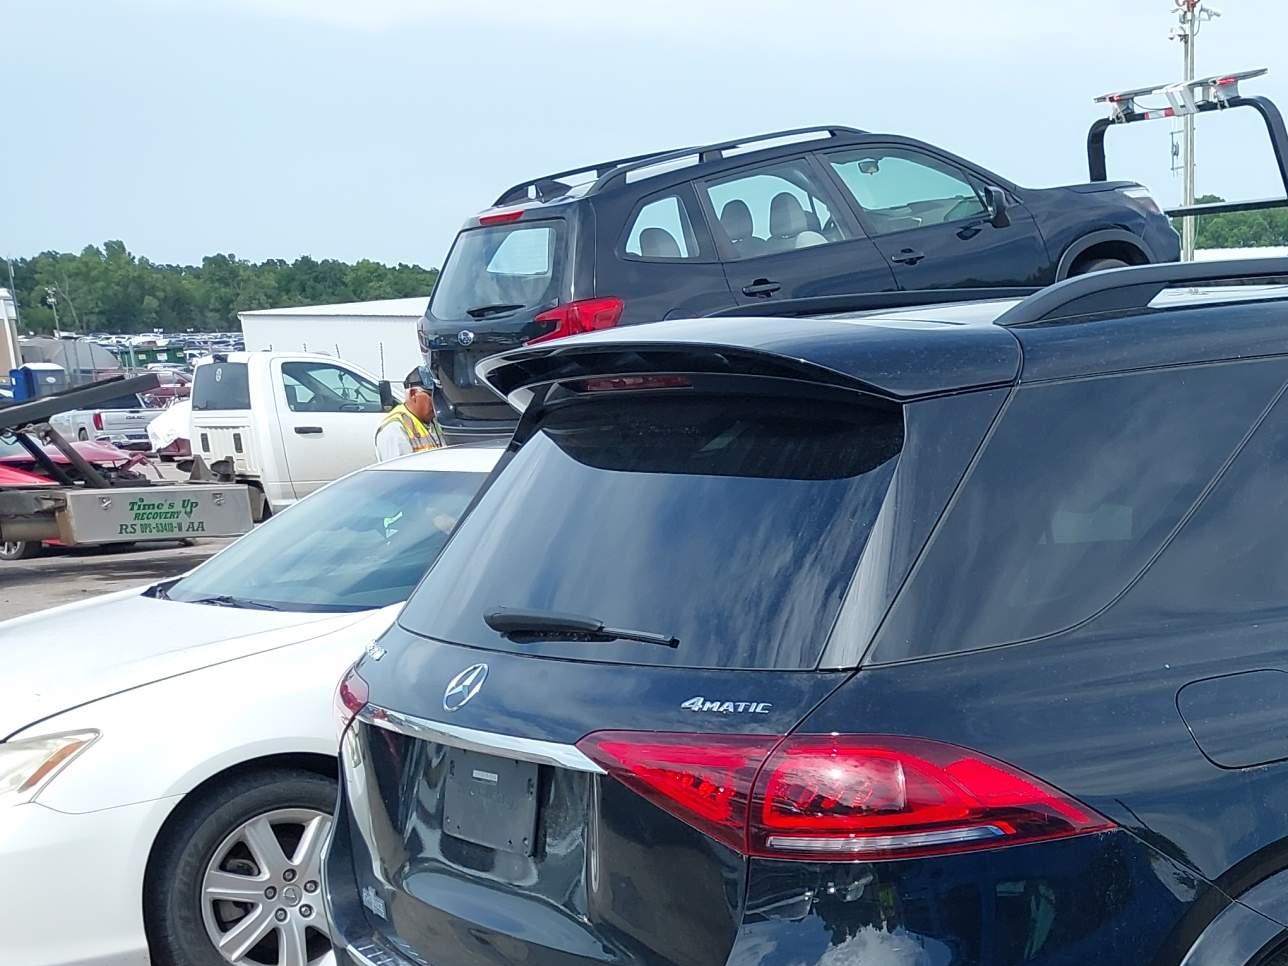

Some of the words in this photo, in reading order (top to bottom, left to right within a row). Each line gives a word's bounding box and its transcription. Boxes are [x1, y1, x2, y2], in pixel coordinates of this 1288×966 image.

[128, 497, 175, 511] Time's
[181, 498, 199, 515] Up
[134, 511, 182, 521] RECOVERY
[118, 523, 137, 535] RS
[185, 521, 206, 532] AA
[681, 696, 773, 713] 4MATIC
